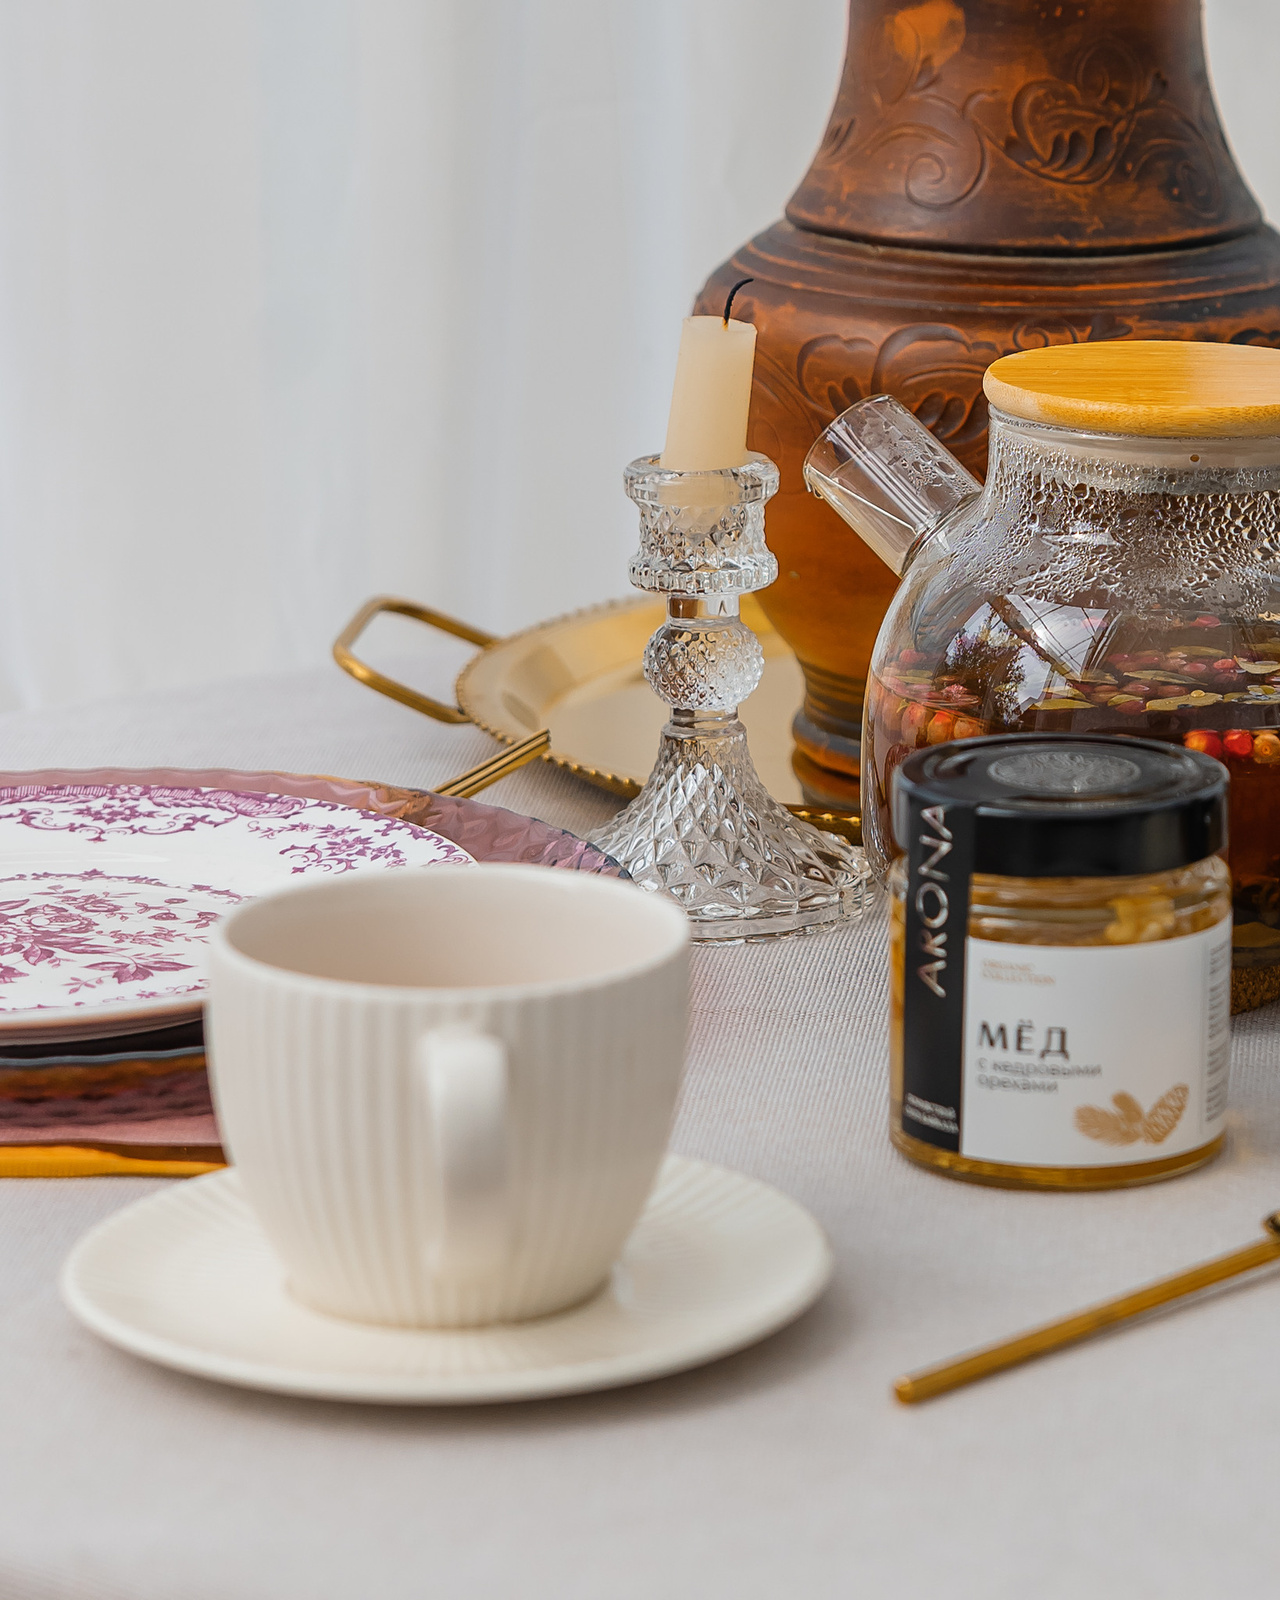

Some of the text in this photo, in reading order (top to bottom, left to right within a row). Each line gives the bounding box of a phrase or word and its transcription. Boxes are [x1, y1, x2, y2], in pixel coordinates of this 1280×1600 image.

[915, 804, 953, 999] ARONA
[977, 1019, 1070, 1061] МЁД
[993, 1060, 1103, 1077] кедровыми
[977, 1074, 1058, 1095] орехами
